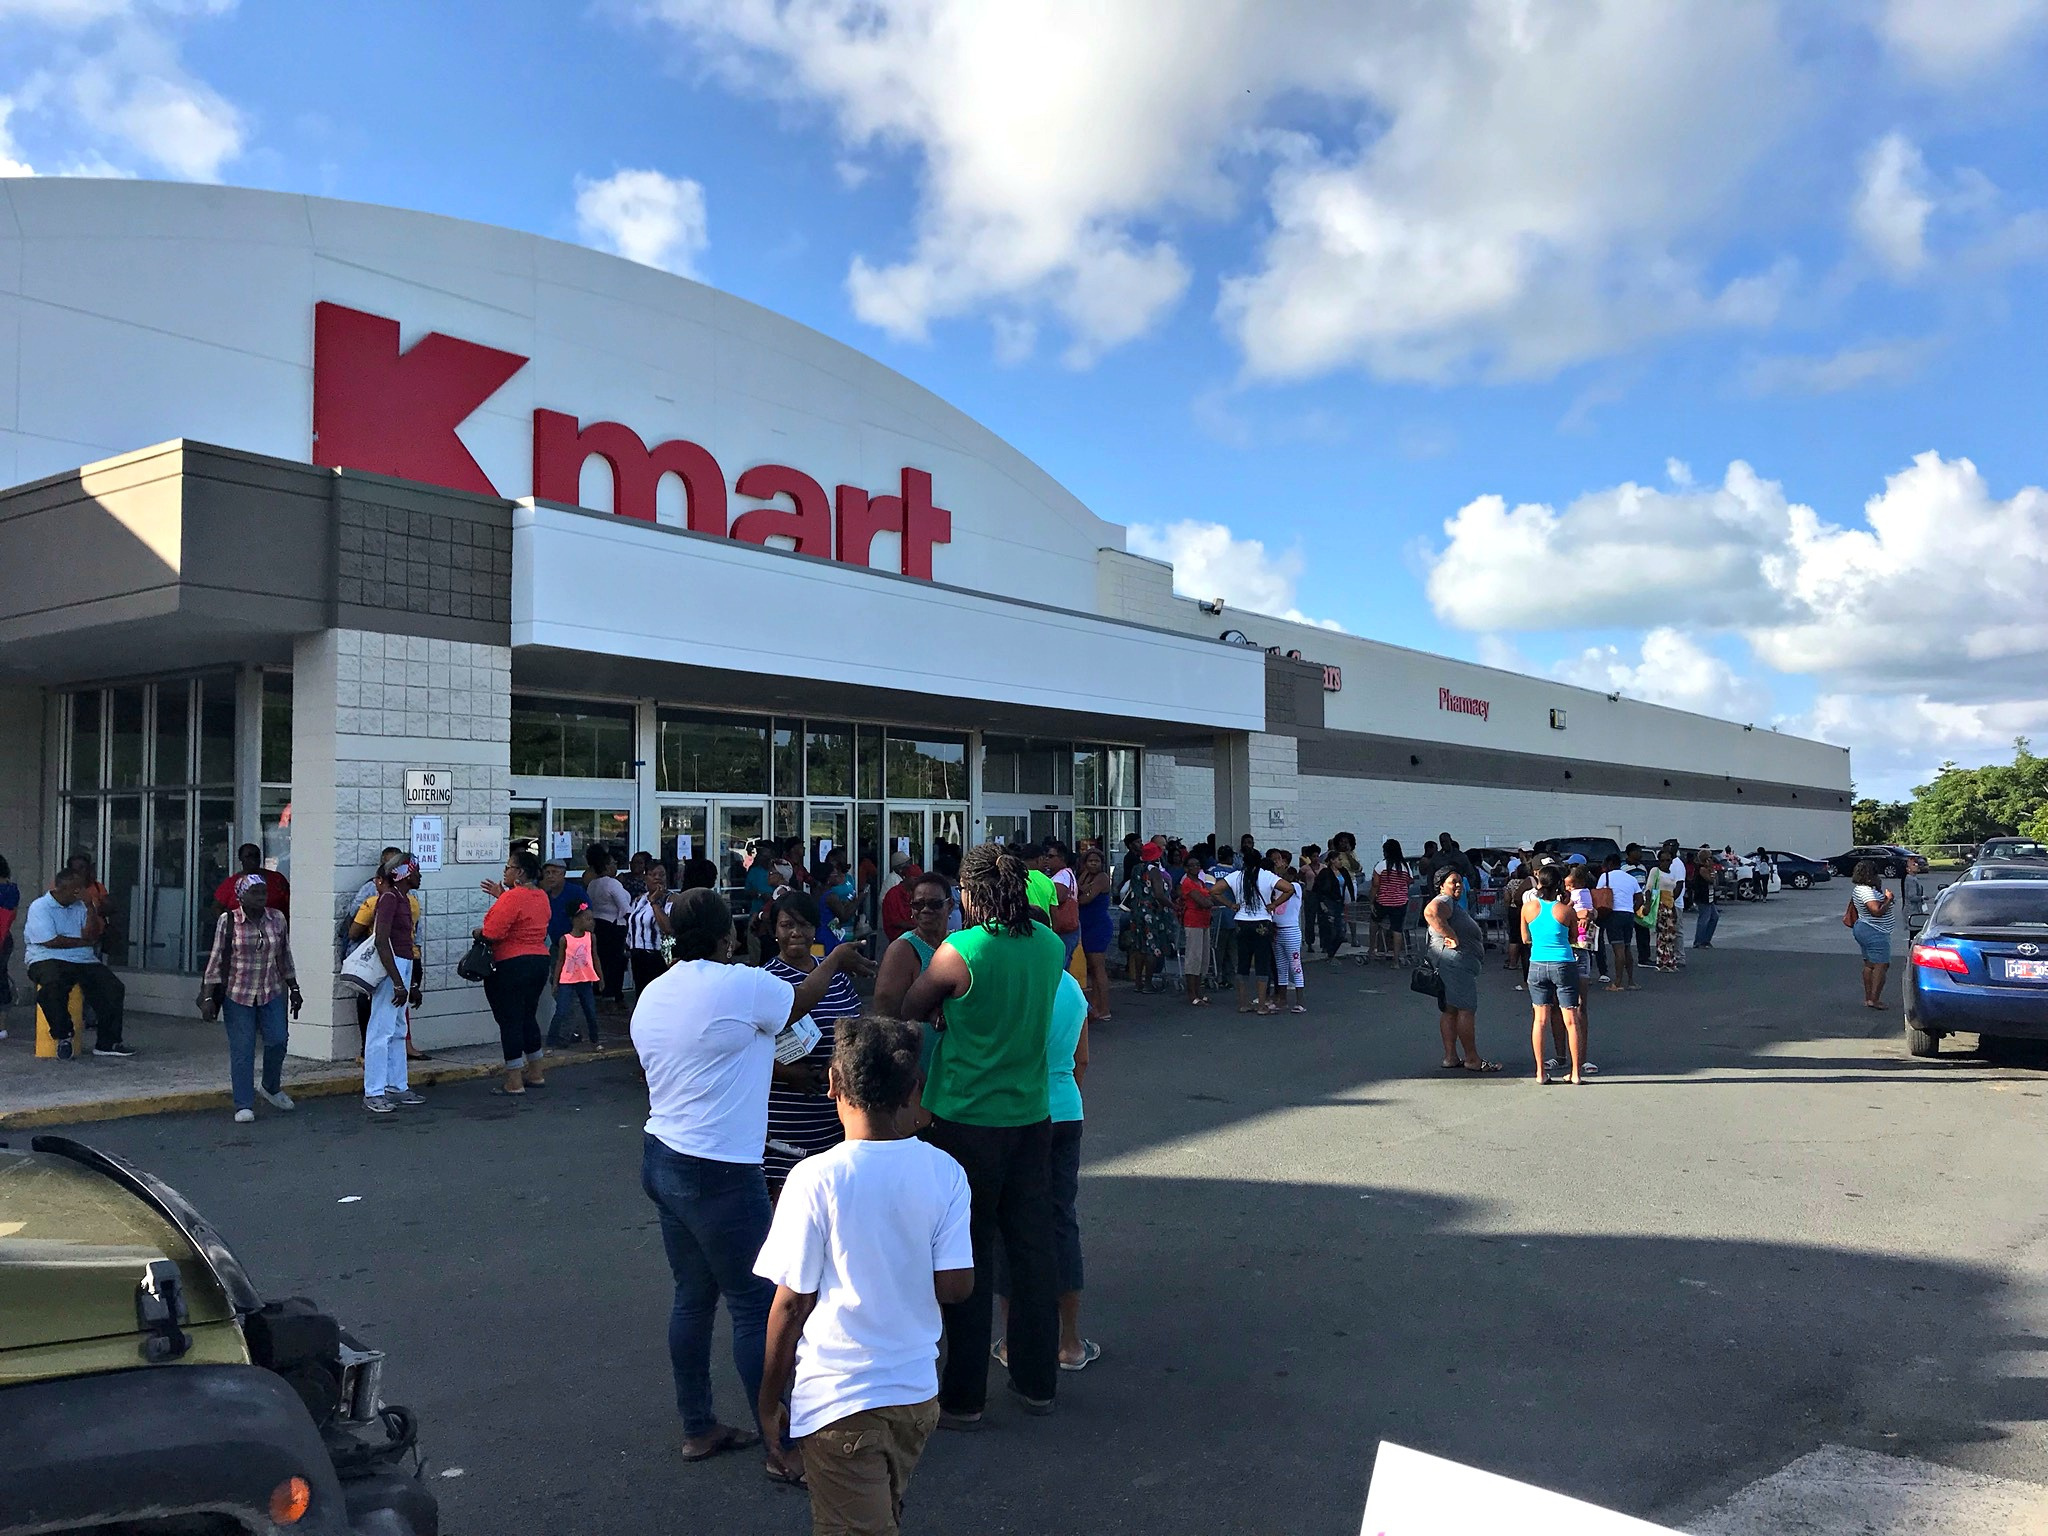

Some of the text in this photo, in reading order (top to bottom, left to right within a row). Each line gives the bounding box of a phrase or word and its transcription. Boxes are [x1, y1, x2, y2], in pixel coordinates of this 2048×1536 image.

[313, 301, 951, 581] Kmart
[1439, 687, 1490, 721] Pharmacy
[423, 774, 436, 786] NO
[407, 789, 451, 801] LOITERING
[423, 821, 431, 830] NO
[416, 833, 440, 842] PARKING
[418, 844, 437, 852] FIRE
[465, 849, 493, 857] IN REAR
[417, 854, 438, 863] LANE
